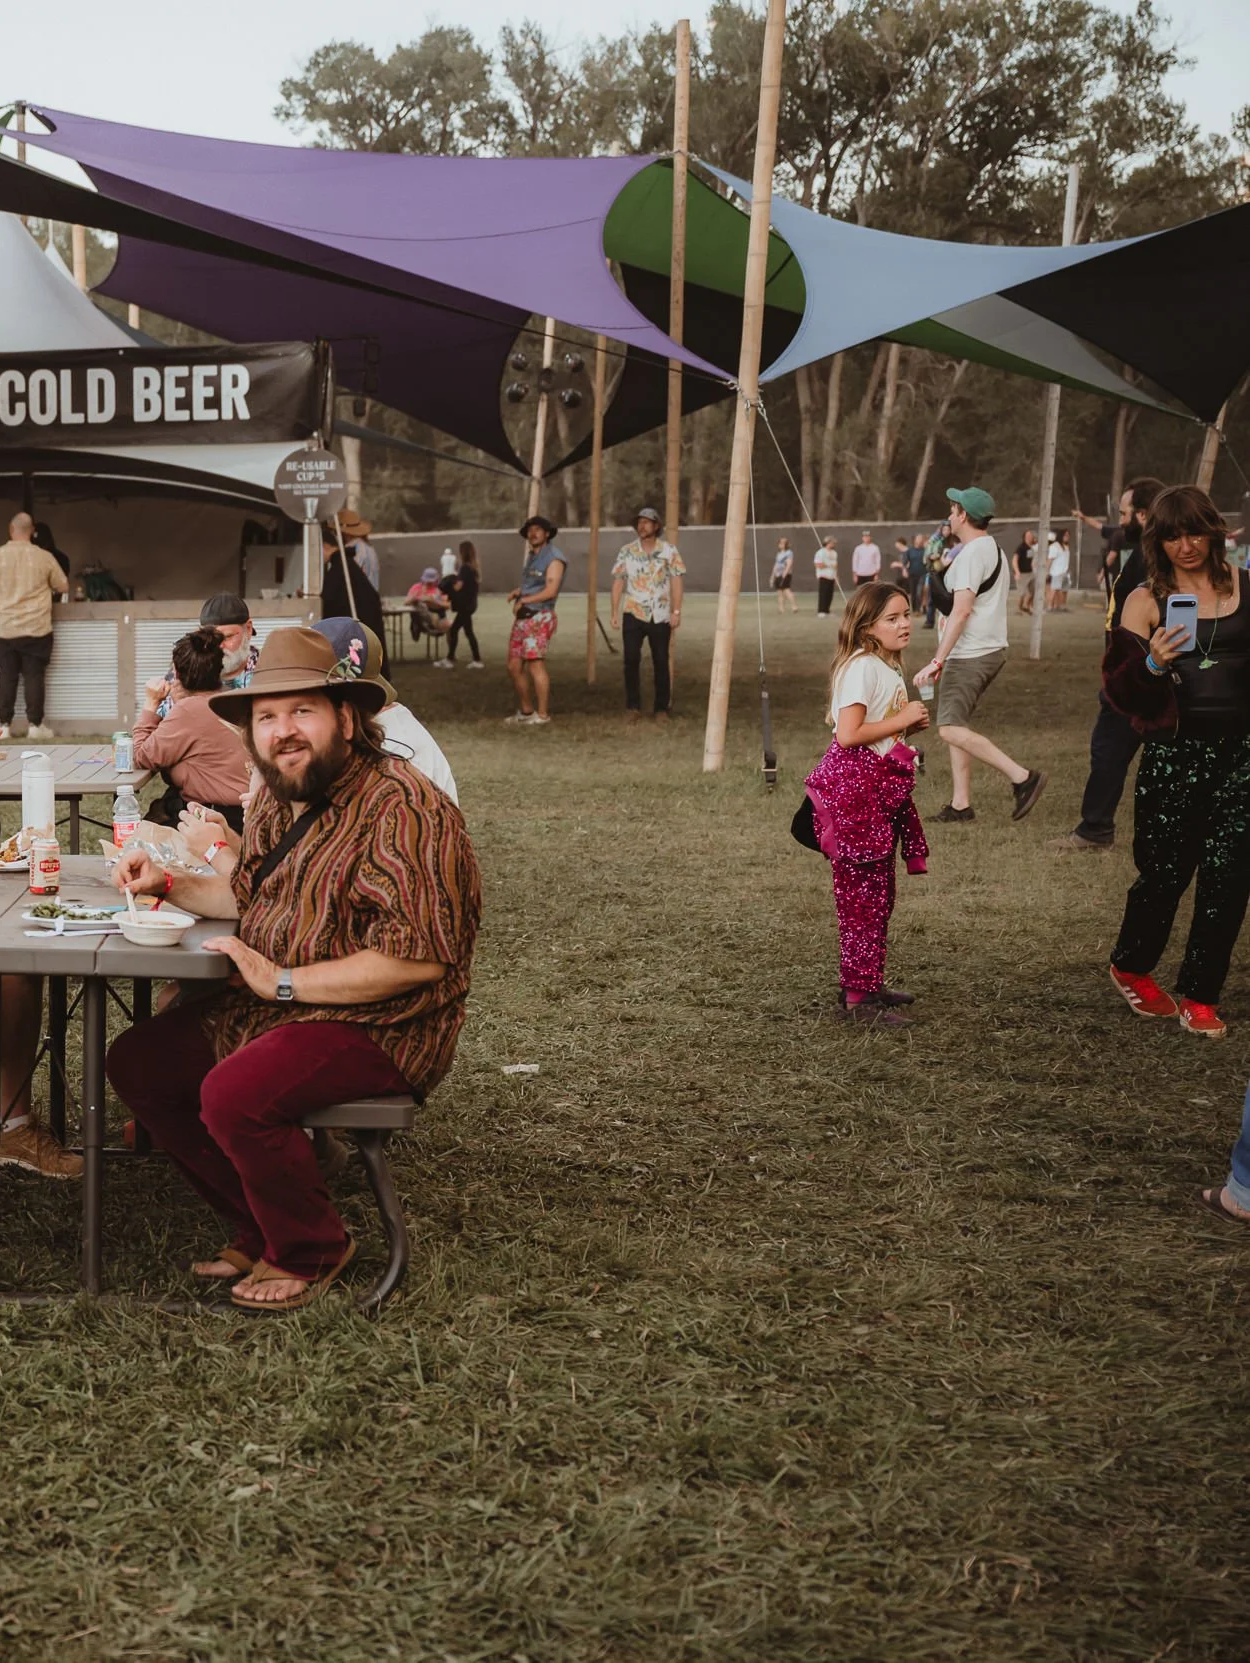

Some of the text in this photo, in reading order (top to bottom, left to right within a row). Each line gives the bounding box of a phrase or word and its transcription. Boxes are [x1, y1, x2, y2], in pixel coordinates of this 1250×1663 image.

[133, 364, 250, 422] BEER
[286, 461, 336, 471] RE-USABLE
[296, 472, 315, 481] CUP
